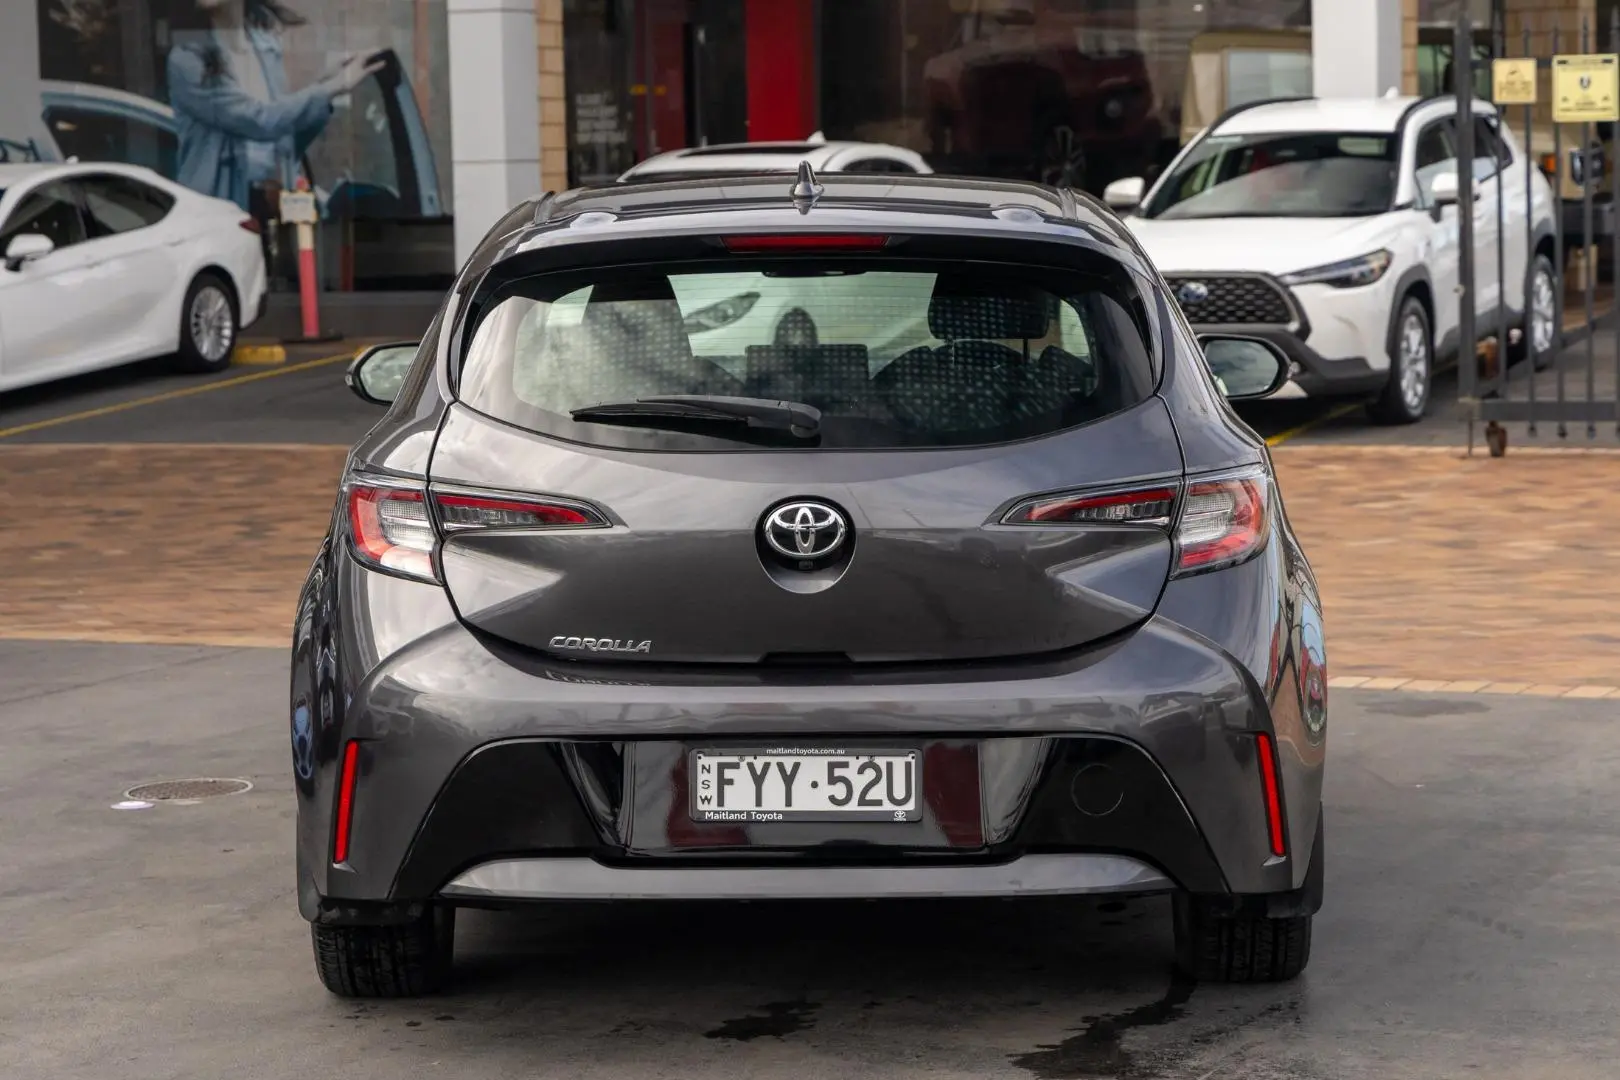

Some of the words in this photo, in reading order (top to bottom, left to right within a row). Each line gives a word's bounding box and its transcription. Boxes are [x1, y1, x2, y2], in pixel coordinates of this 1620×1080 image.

[548, 636, 652, 653] COROLLA
[766, 747, 845, 755] maitlandtoyota.com.au
[700, 764, 712, 805] NSW
[705, 811, 746, 820] Maitland
[751, 811, 783, 821] Toyota
